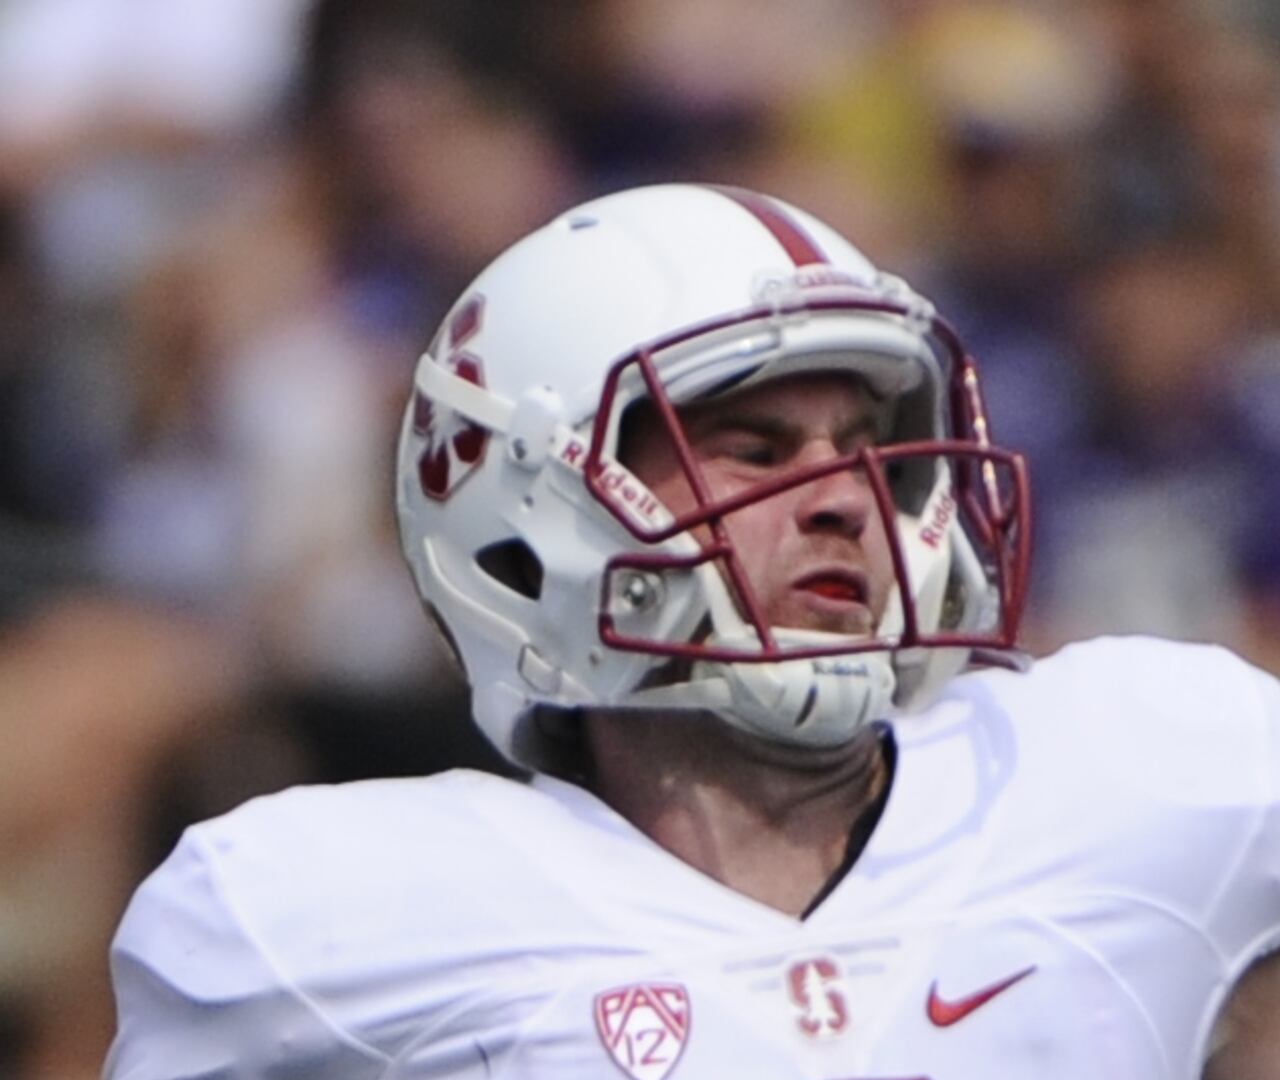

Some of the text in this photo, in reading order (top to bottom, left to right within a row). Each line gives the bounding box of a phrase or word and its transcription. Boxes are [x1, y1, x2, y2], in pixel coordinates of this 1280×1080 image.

[596, 983, 689, 1048] PAC
[786, 957, 849, 1036] S
[624, 1026, 669, 1067] 12
